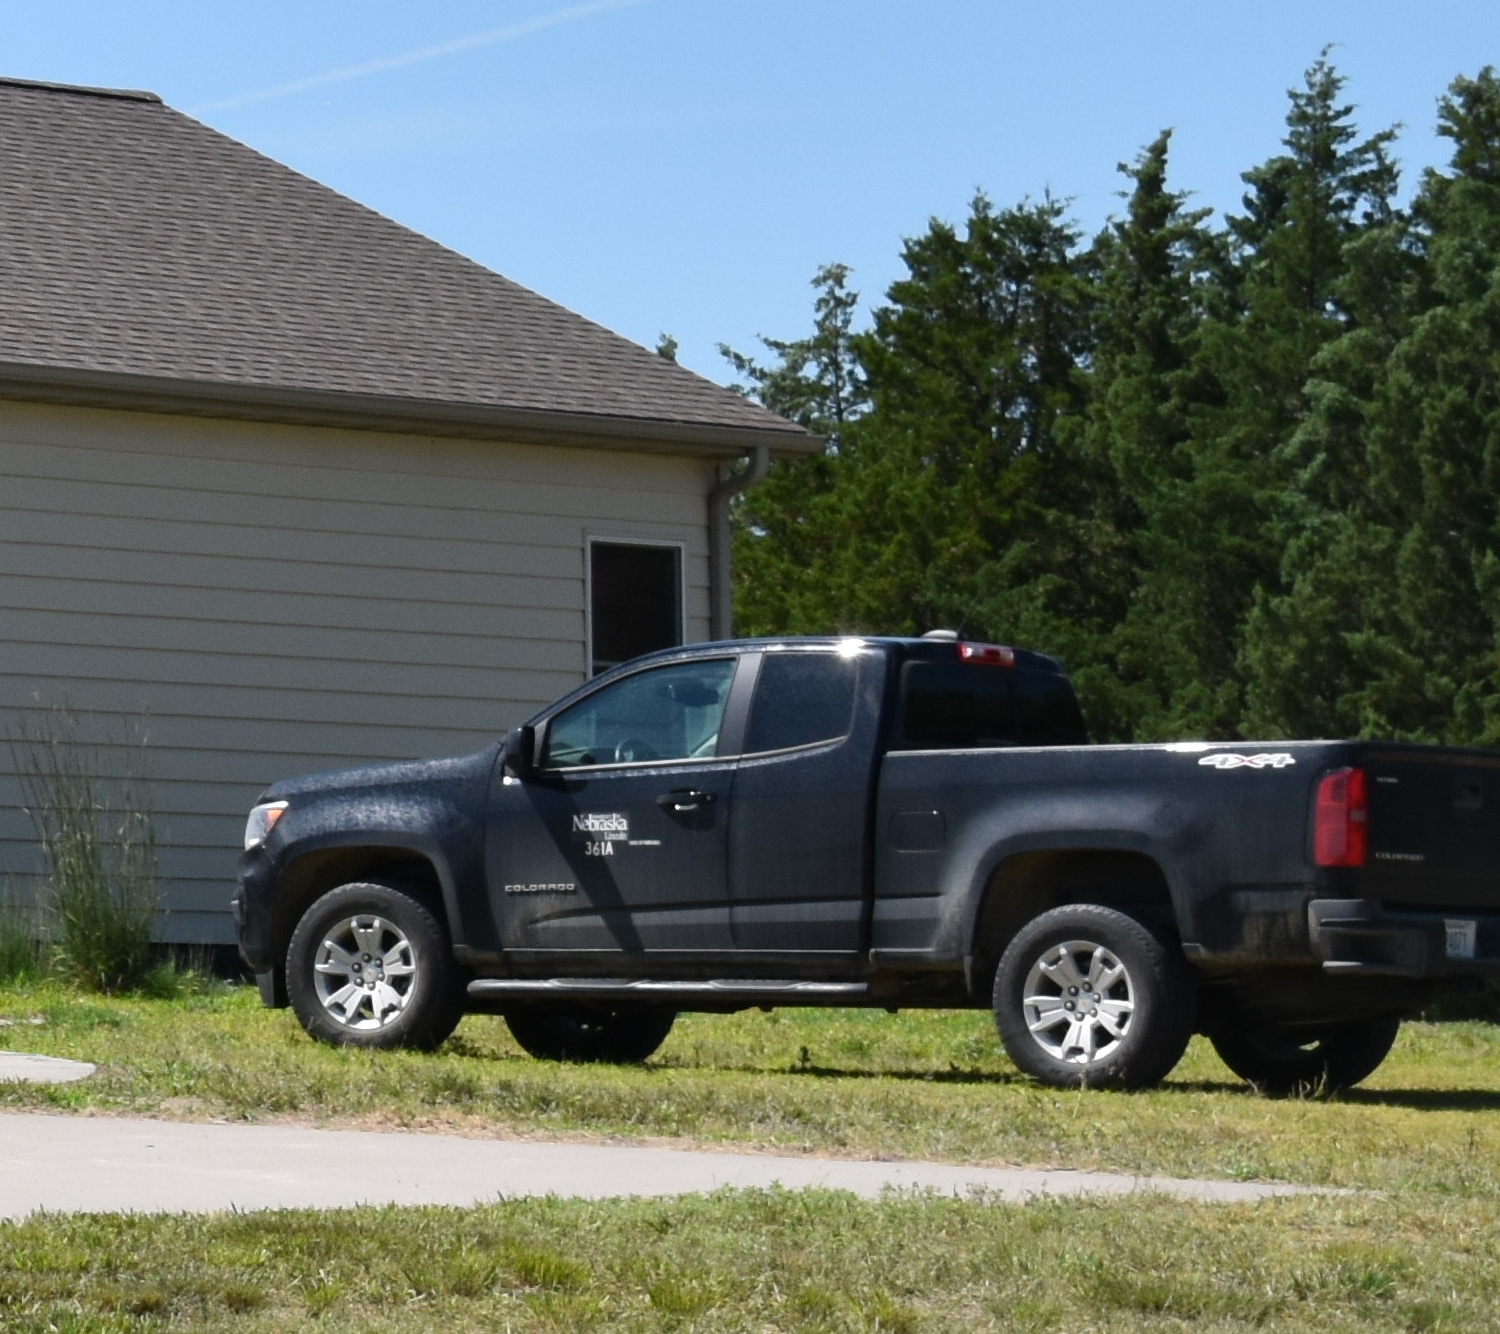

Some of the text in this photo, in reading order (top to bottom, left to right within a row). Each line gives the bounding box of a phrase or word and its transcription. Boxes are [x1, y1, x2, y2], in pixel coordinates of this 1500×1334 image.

[572, 814, 628, 831] Nebraska
[585, 841, 614, 856] 361A
[504, 883, 575, 892] COLORADO
